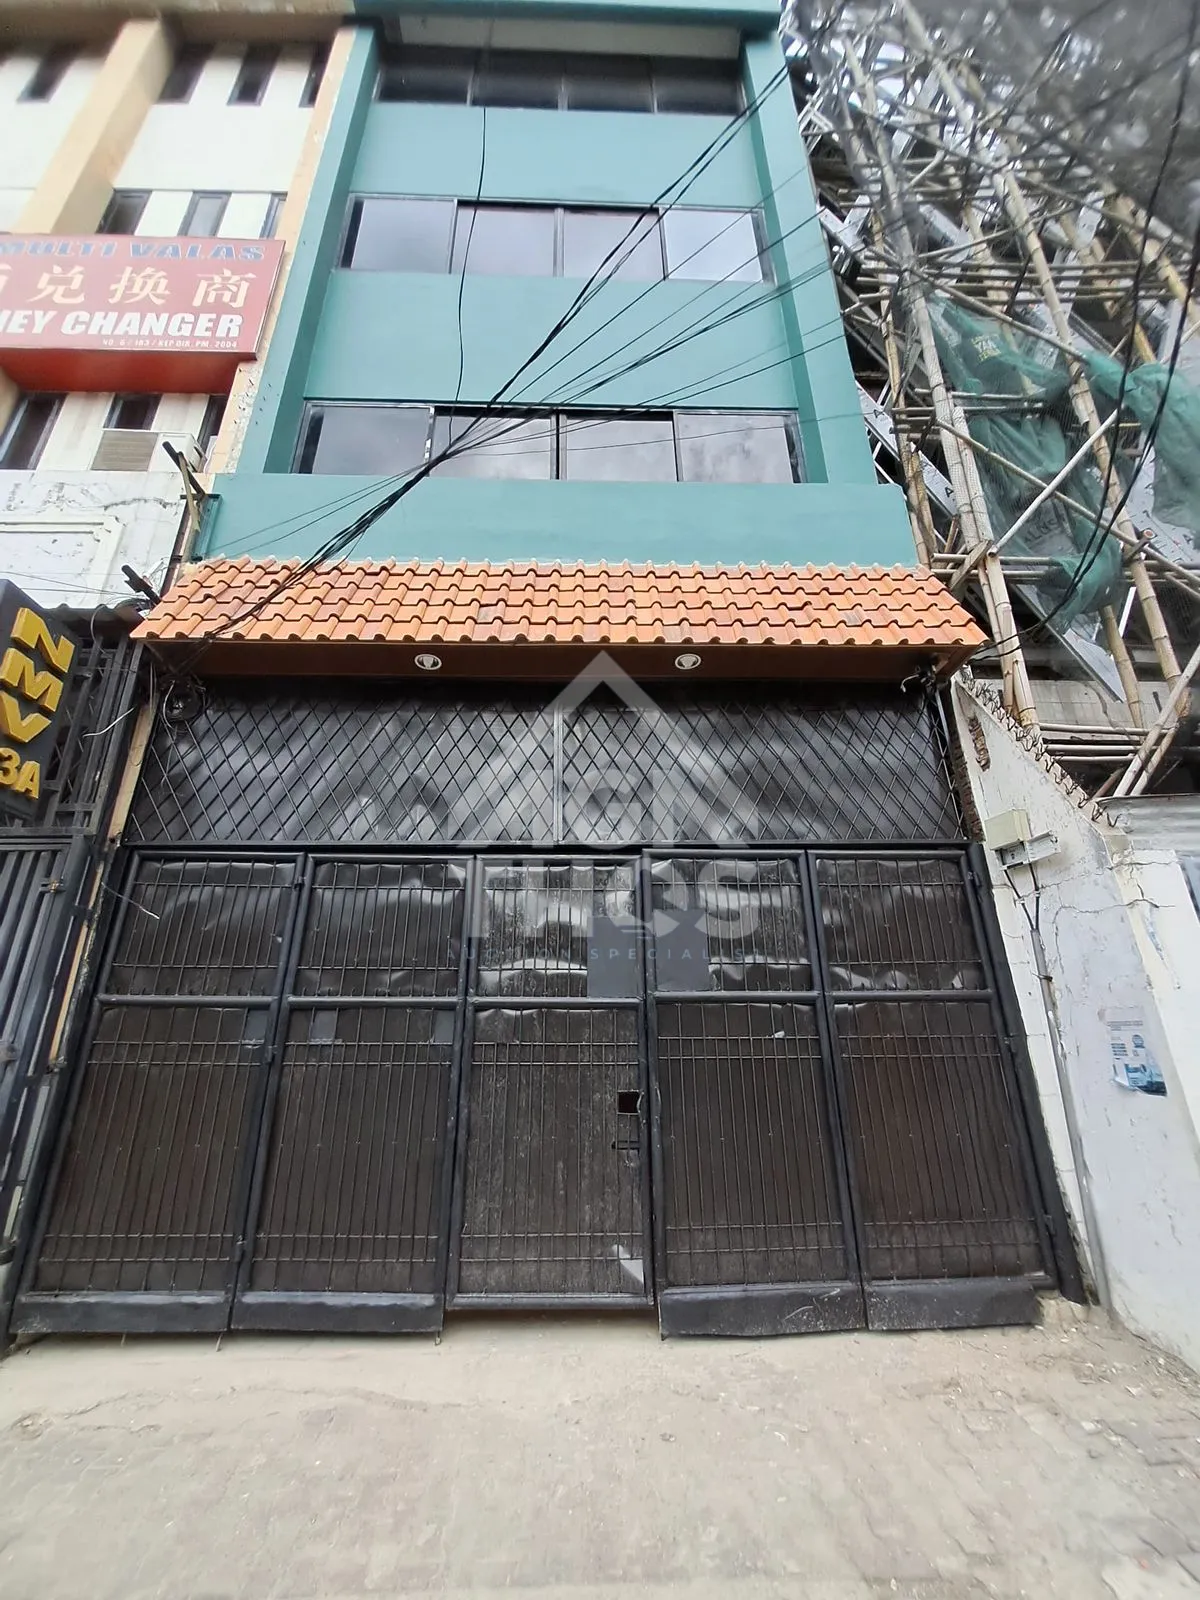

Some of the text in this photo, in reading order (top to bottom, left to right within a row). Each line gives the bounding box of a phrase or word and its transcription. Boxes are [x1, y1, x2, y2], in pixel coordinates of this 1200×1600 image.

[129, 243, 265, 260] VALAS
[0, 263, 256, 308] 兑换商
[60, 311, 243, 338] CHANGER
